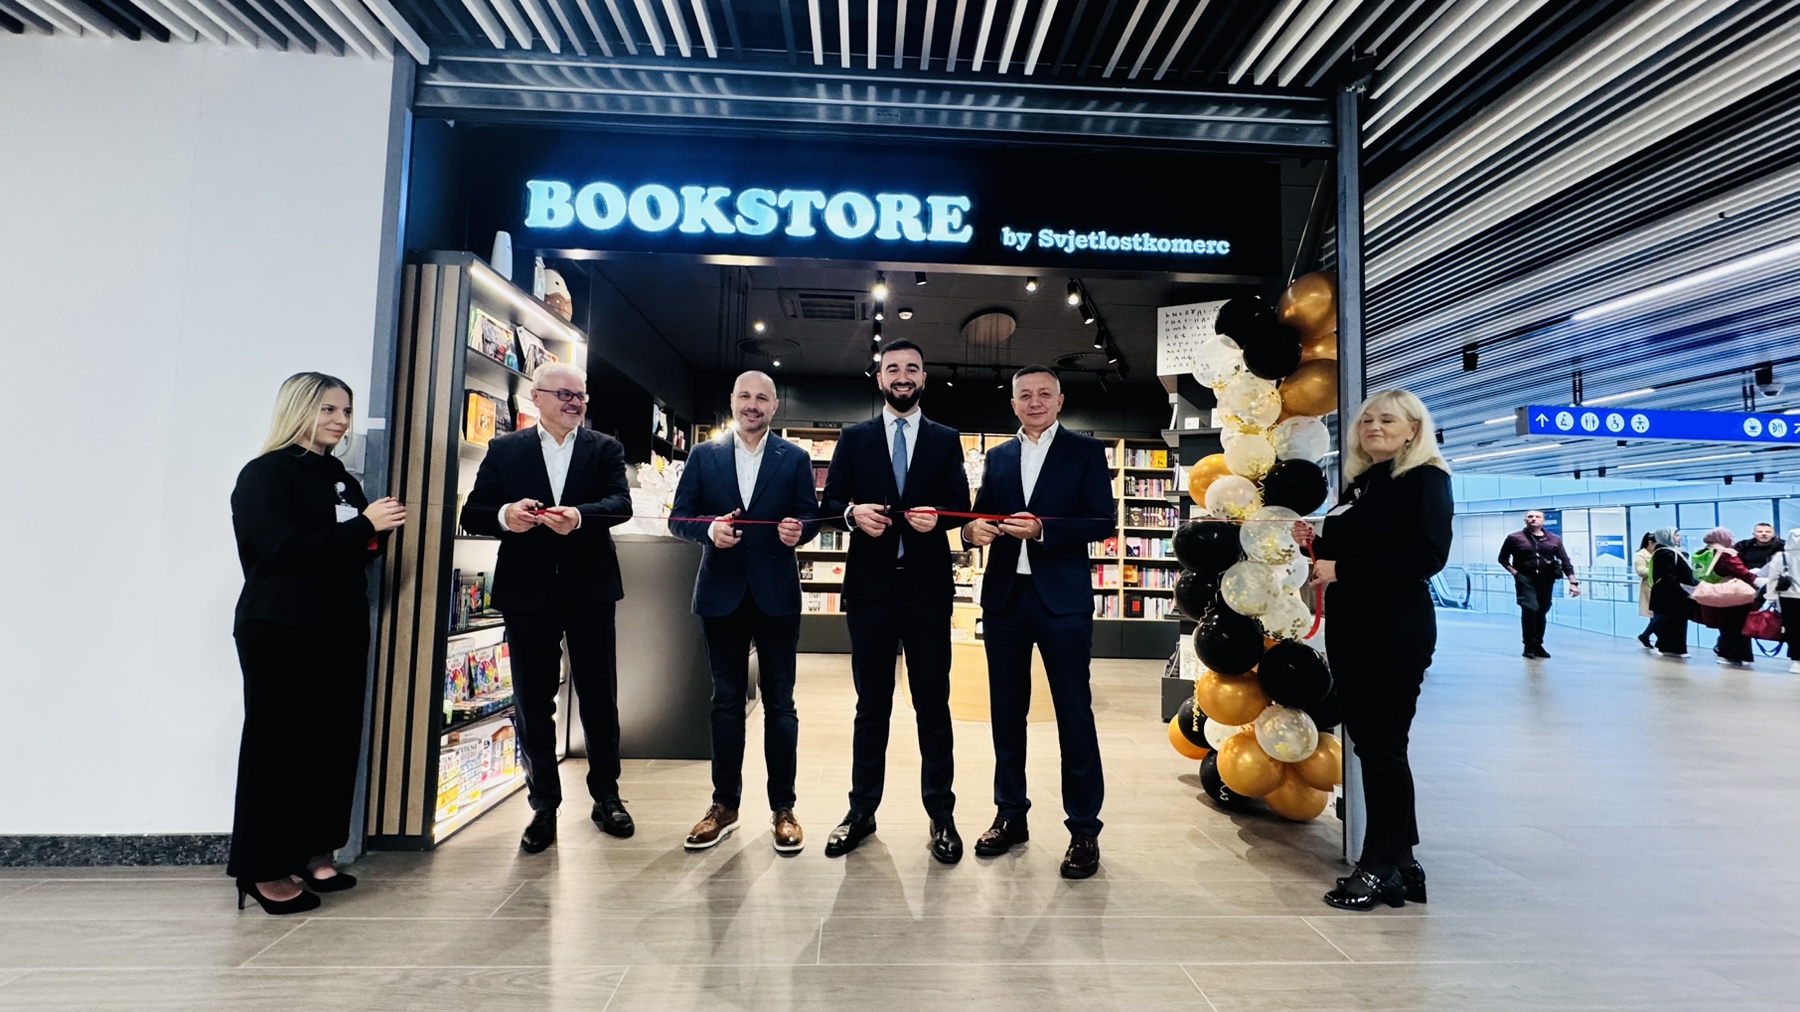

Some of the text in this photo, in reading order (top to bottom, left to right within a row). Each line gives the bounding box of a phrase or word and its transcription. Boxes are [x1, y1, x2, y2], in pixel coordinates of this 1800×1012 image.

[524, 179, 974, 244] BOOKSTORE
[1001, 226, 1231, 256] by Svjetlostkomerc
